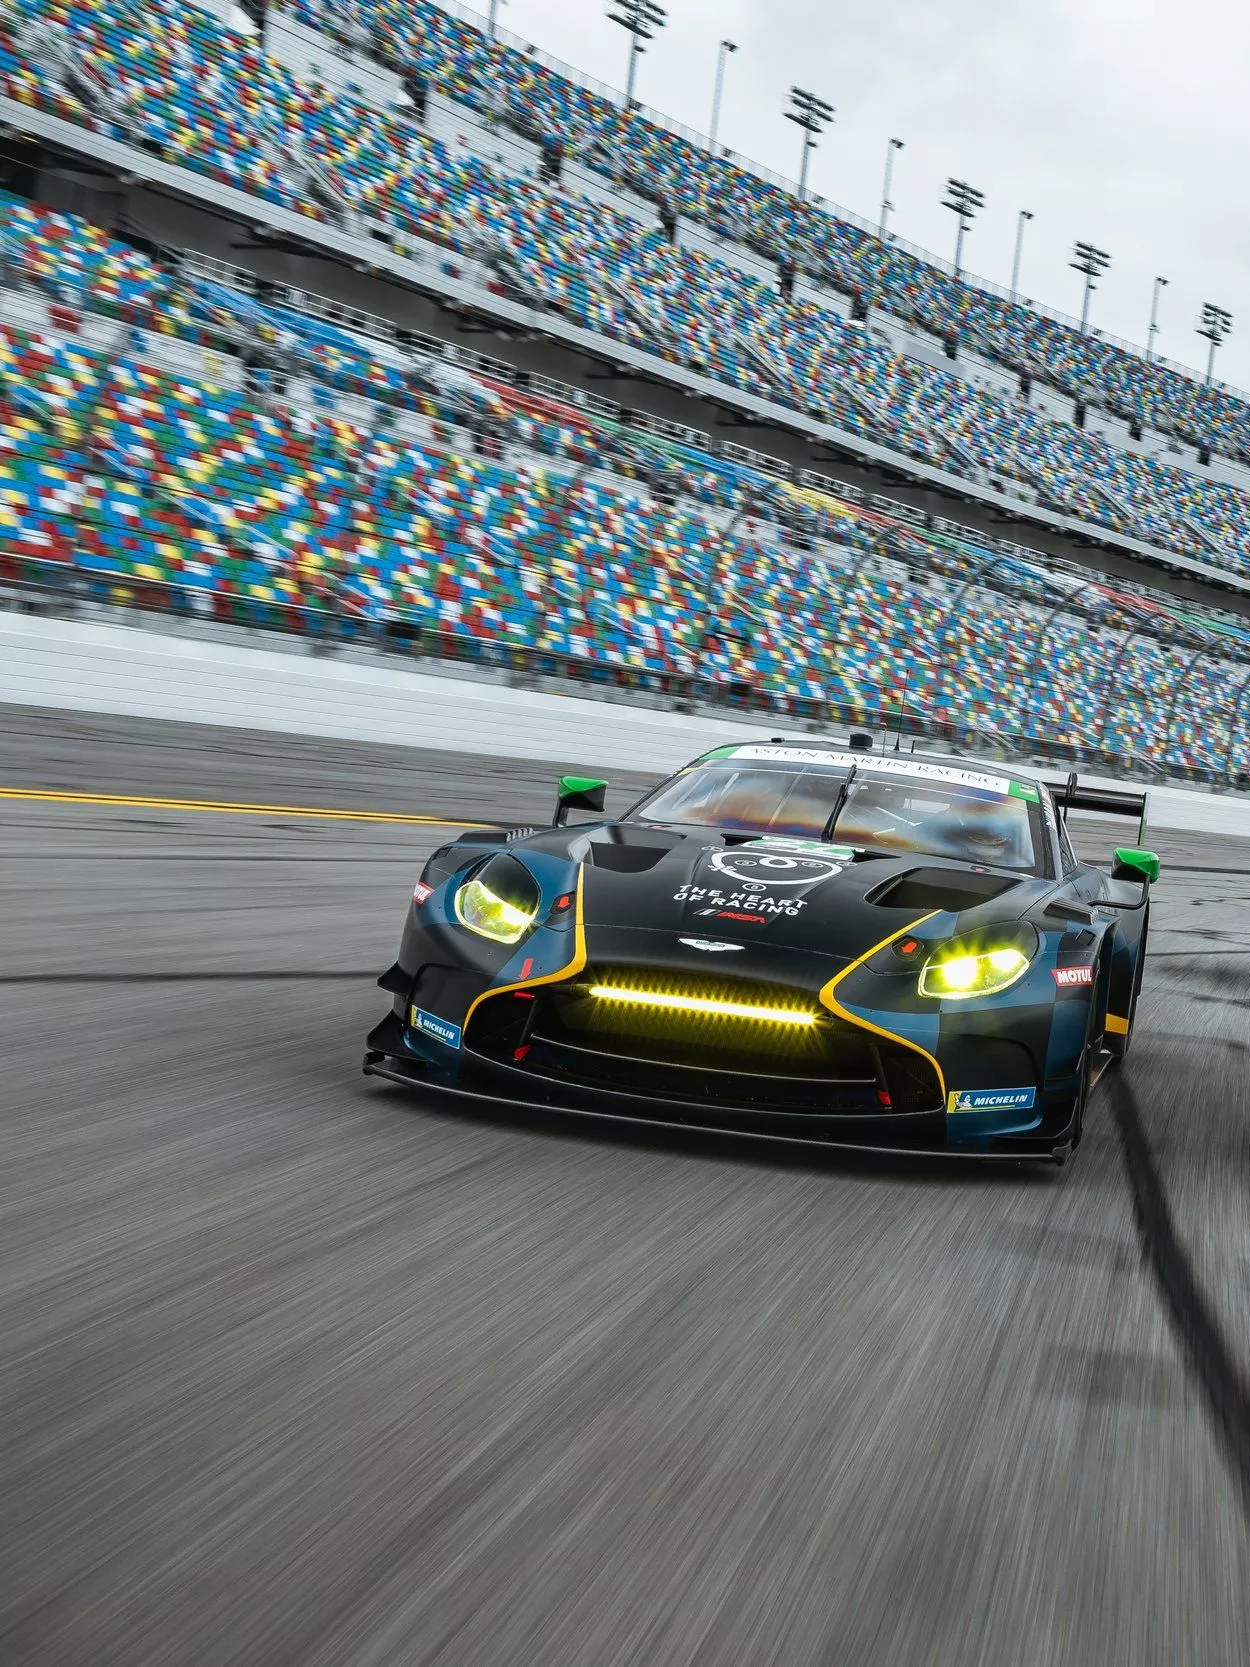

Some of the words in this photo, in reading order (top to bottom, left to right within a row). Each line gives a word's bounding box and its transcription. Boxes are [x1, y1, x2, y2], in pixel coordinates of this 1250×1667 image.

[753, 747, 818, 759] ASTON
[825, 753, 908, 769] MARTIN
[917, 765, 1000, 787] RACING
[673, 892, 704, 901] OF
[710, 897, 800, 916] RACING
[679, 884, 723, 898] THE
[730, 891, 808, 909] HEART
[716, 911, 766, 924] IMSA
[1056, 968, 1093, 984] MOTUL
[423, 1019, 455, 1040] MICHELIN
[973, 1094, 1029, 1106] MICHELIN
